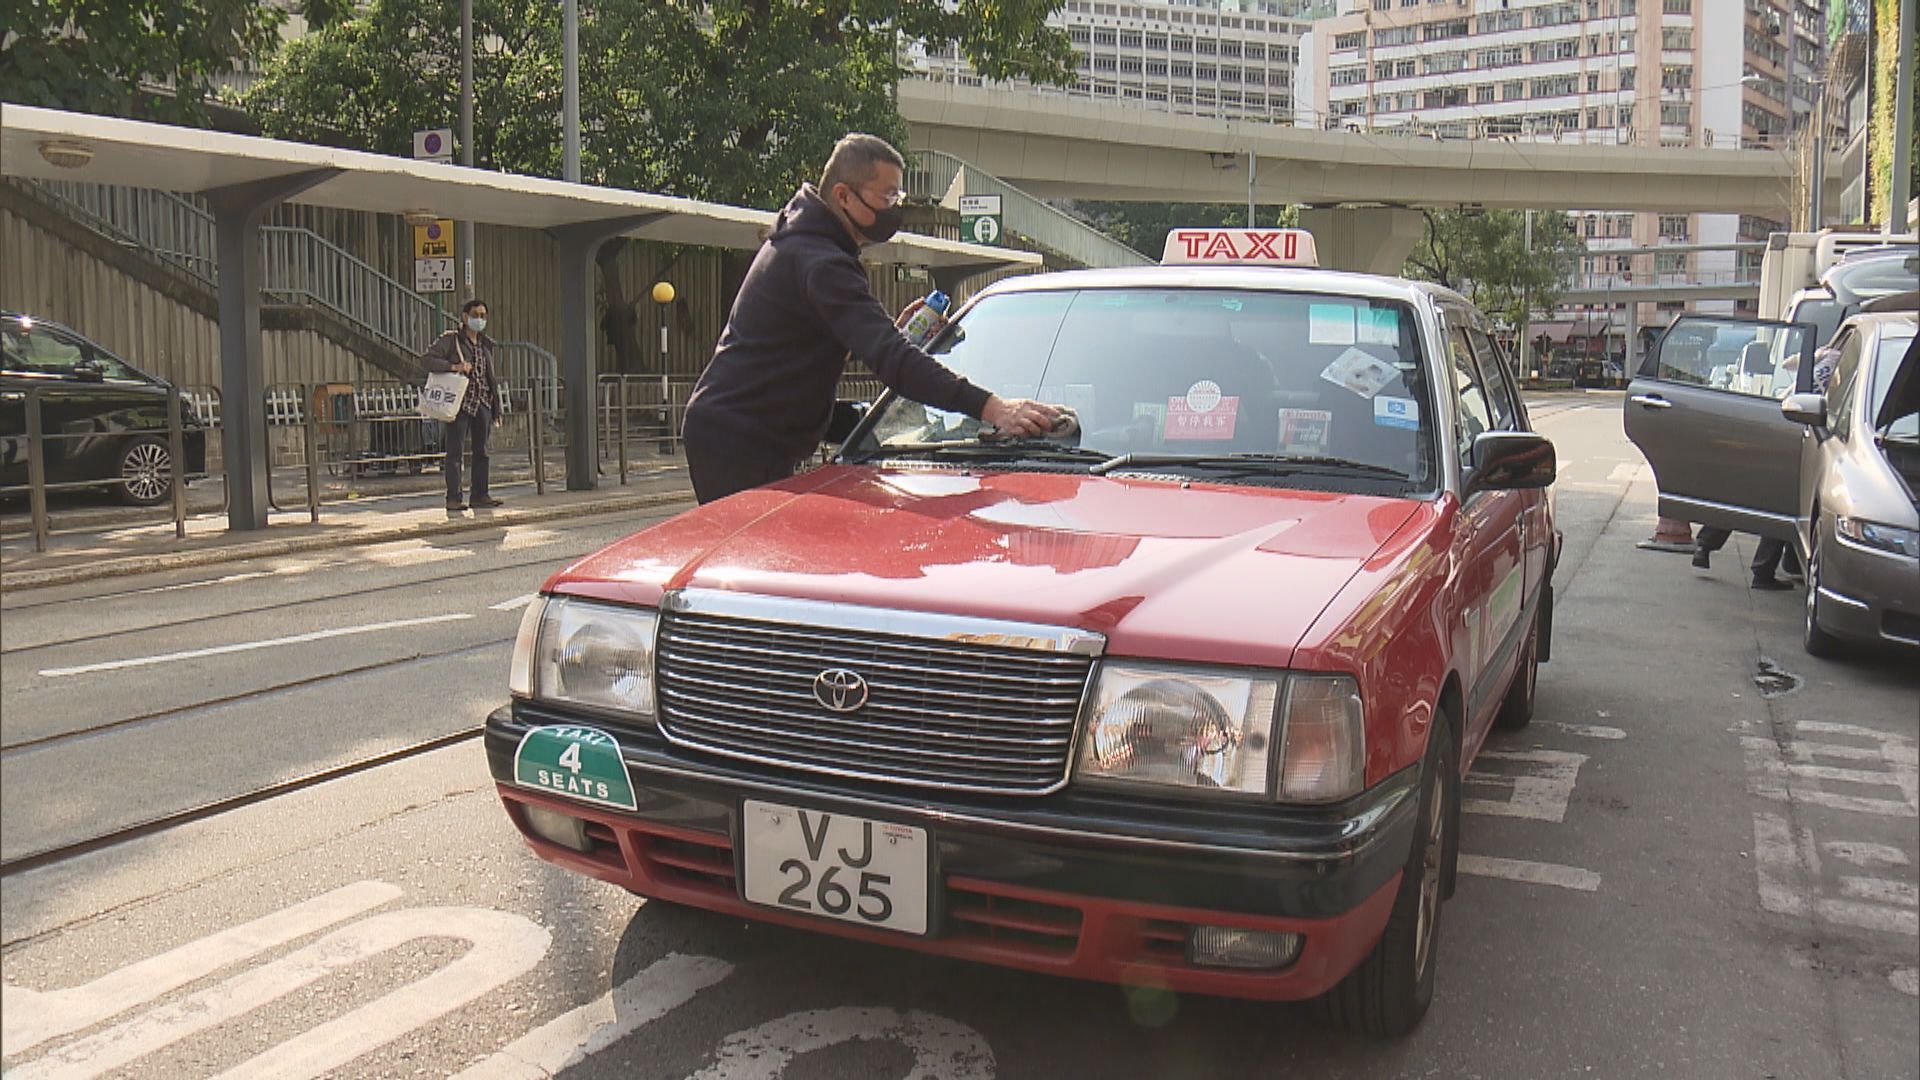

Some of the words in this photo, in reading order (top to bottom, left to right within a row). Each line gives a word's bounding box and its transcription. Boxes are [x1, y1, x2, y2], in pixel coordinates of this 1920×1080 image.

[1178, 232, 1297, 259] TAXI
[440, 260, 447, 271] 7
[440, 278, 453, 289] 12
[555, 728, 606, 745] TAXI
[559, 742, 581, 774] 4
[538, 770, 609, 799] SEATS
[797, 810, 873, 868] VJ
[778, 858, 893, 922] 265
